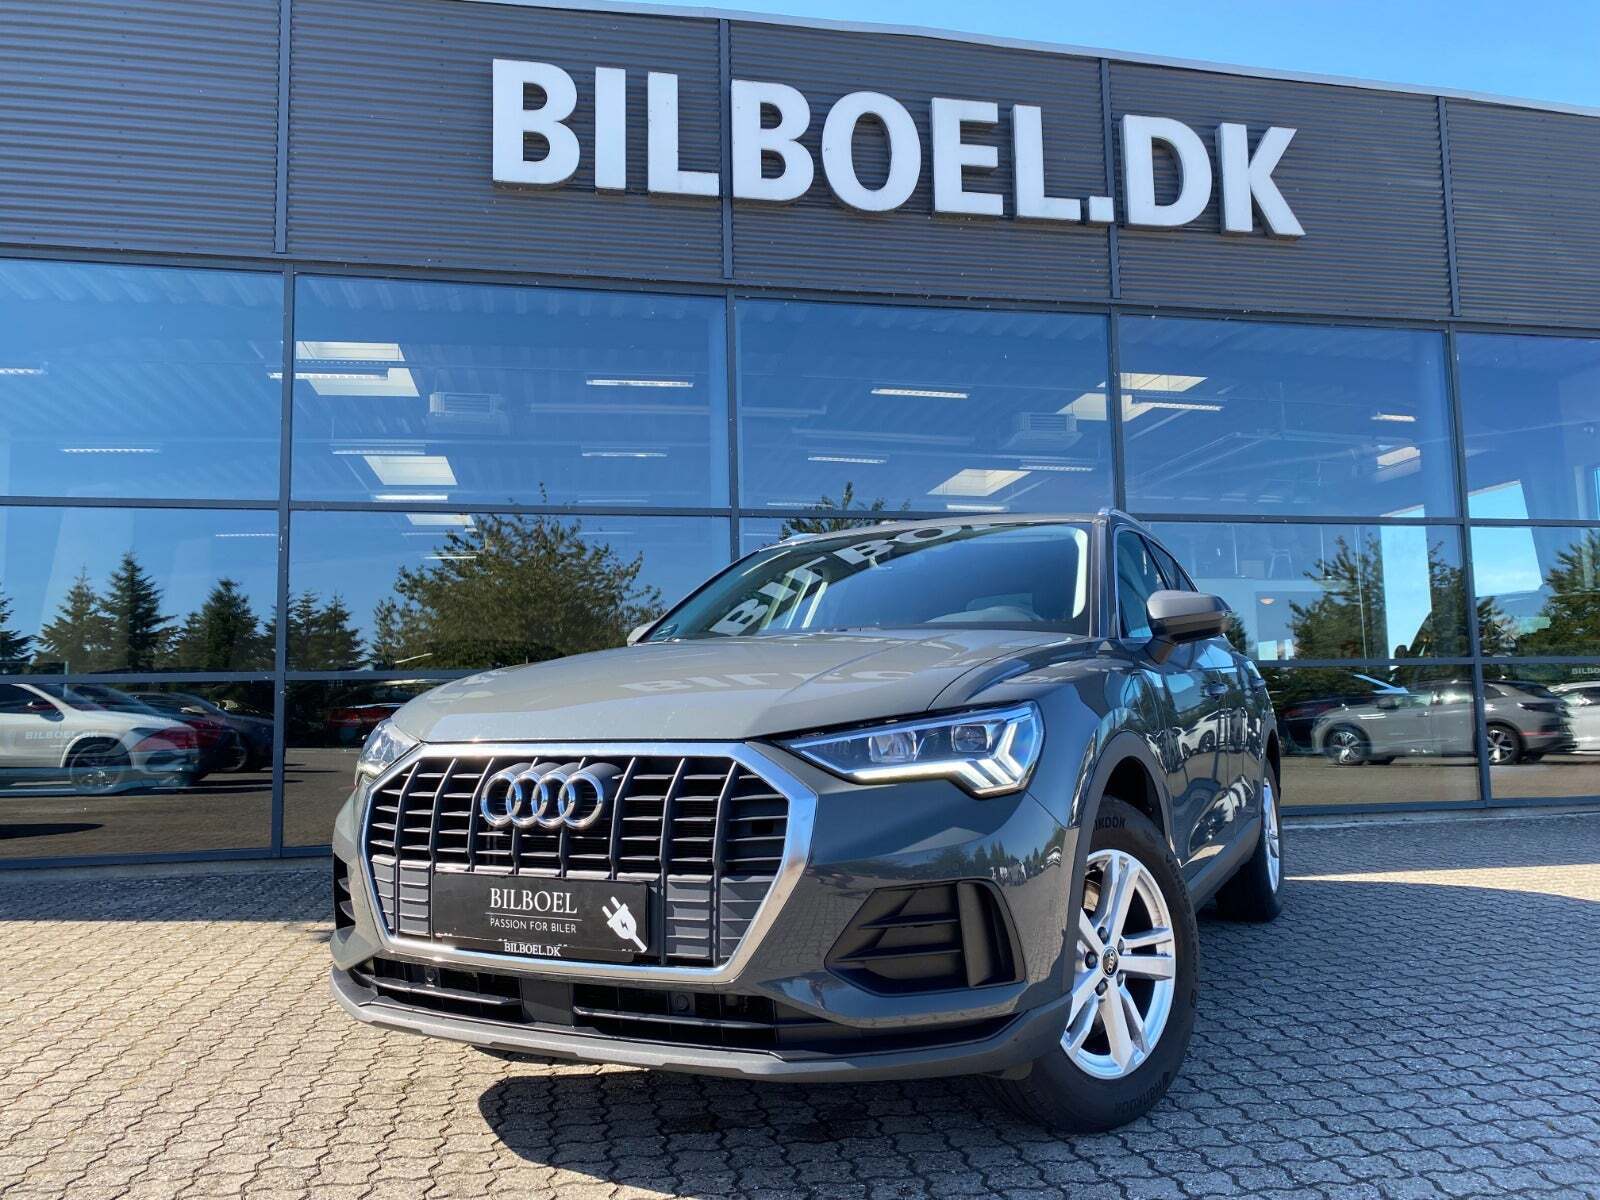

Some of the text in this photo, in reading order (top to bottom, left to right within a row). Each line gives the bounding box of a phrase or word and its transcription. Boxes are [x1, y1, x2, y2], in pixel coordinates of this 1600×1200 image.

[492, 58, 1306, 238] BILBOEL.DK
[489, 887, 578, 914] BILBOEL
[490, 917, 577, 934] PASSION FOR BILER
[504, 942, 561, 957] BILBOEL.DK
